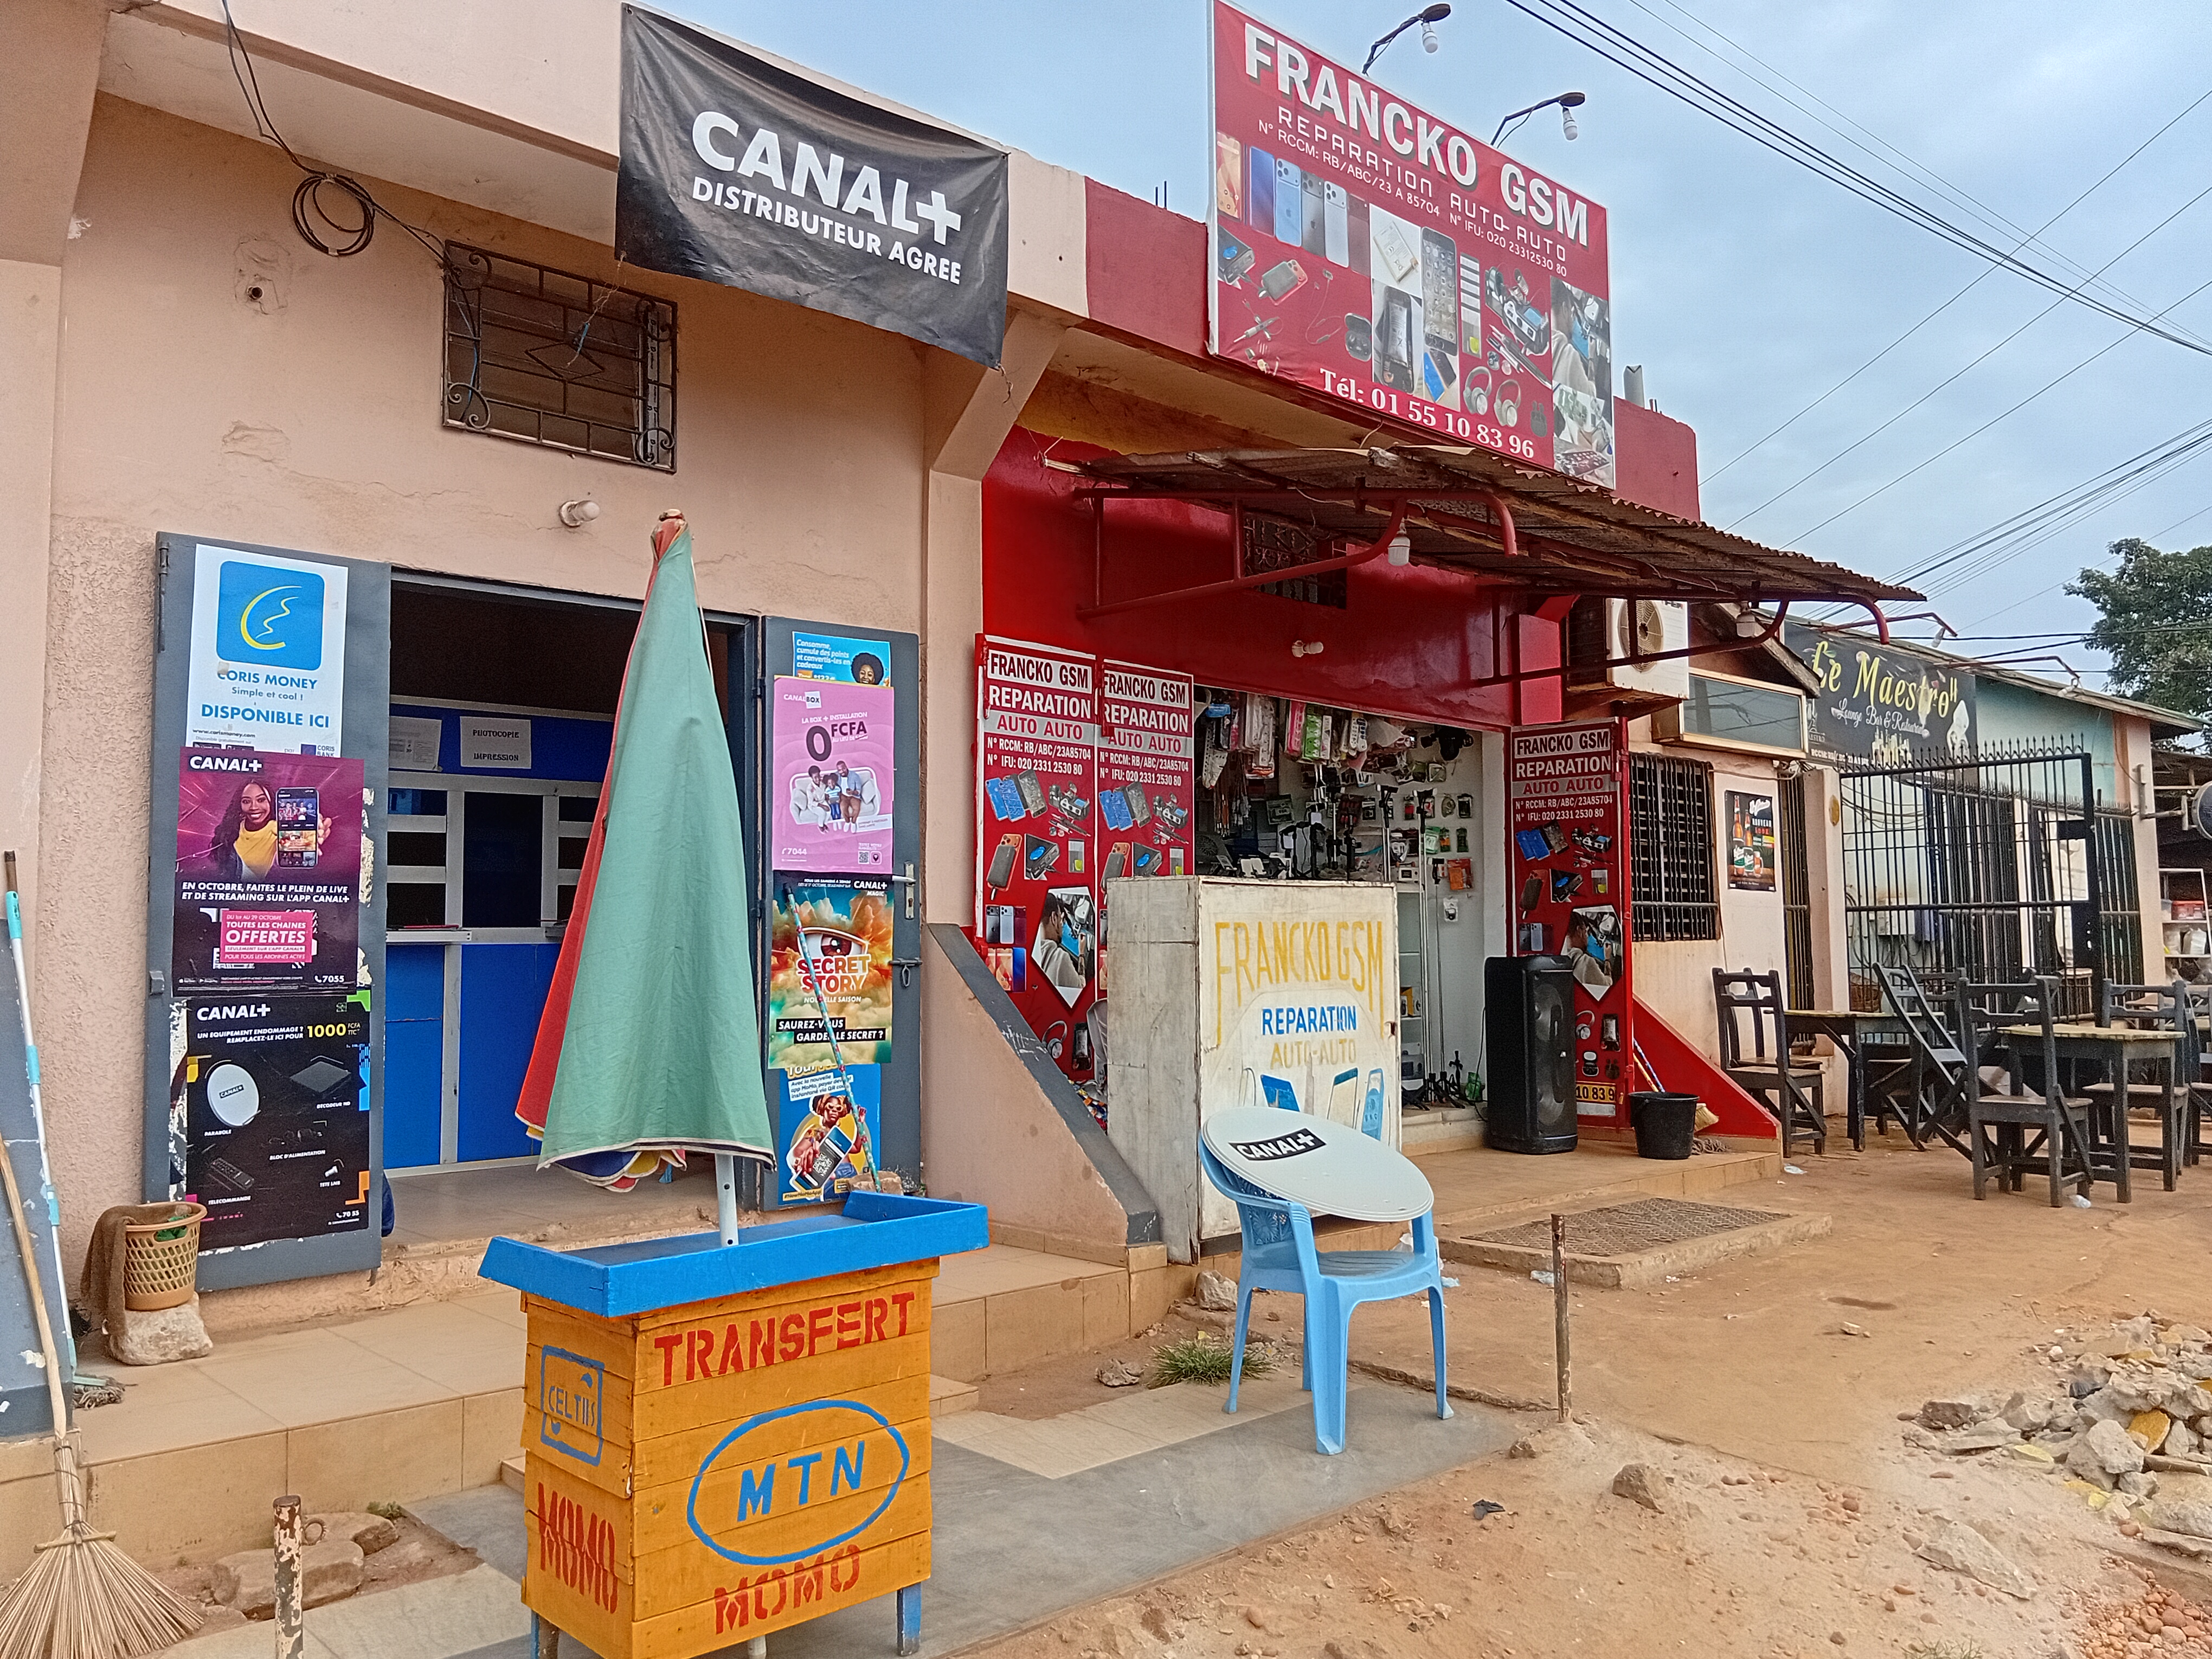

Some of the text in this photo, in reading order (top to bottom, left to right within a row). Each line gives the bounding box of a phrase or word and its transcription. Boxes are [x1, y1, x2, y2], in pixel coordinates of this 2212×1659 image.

[1245, 23, 1587, 247] FRANCKO GSM
[1278, 106, 1432, 197] REPARATION
[692, 111, 961, 245] CANAL+
[1259, 119, 1439, 217] N° RCCM: RB/ABC/23 A 85704
[692, 177, 961, 284] DISTRIBUTEUR AGREE
[1450, 213, 1567, 277] N° IFU: 020 23312530 80
[1320, 369, 1534, 459] Tél: 01 55 10 83 96
[796, 639, 831, 650] Consomme,
[217, 670, 318, 690] CORIS MONEY
[991, 653, 1088, 689] FRANCKO GSM
[232, 686, 263, 698] Simple
[278, 691, 297, 701] cool
[989, 685, 1091, 719] REPARATION
[1161, 682, 1185, 704] GSM
[201, 704, 329, 728] DISPONIBLE ICI
[830, 712, 867, 721] INSTALLATION
[1104, 703, 1188, 733] REPARATION
[473, 729, 519, 738] PHOTOCOPIE
[831, 721, 867, 737] FCFA
[997, 715, 1083, 740] AUTO AUTO
[806, 725, 832, 762] 0
[987, 737, 1091, 760] N° RCCM: RB/ABC/23A85704
[1108, 731, 1181, 753] AUTO AUTO
[1517, 731, 1609, 755] FRANCKO GSM
[189, 756, 262, 772] CANAL+
[473, 753, 519, 761] IMPRESSION
[987, 754, 1082, 775] N° IFU: 020 2331 2530 80
[1516, 756, 1611, 777] REPARATION
[1100, 768, 1109, 778] N°
[1112, 769, 1124, 780] IFU:
[1126, 770, 1138, 782] 020
[1140, 772, 1155, 784] 2331
[1156, 774, 1172, 785] 2530
[1523, 777, 1604, 795] AUTO AUTO
[198, 883, 244, 892] OCTOBRE,
[854, 881, 887, 889] CANAL+
[208, 892, 264, 901] STREAMING
[798, 956, 870, 974] SECRET
[802, 975, 866, 993] STORY
[1216, 921, 1384, 1046] FRANCKO GSM
[197, 1004, 271, 1021] CANAL+
[1262, 1006, 1356, 1035] REPARATION
[227, 1035, 274, 1044] REMPLACEZ-LE
[307, 1024, 346, 1038] 1000
[796, 1033, 833, 1041] GARDE
[847, 1031, 877, 1039] SECRET
[1270, 1038, 1355, 1069] AUTO-AUTO
[220, 1085, 243, 1097] CANAL+
[791, 1078, 804, 1086] Avec
[1576, 1086, 1589, 1098] 10
[1592, 1087, 1605, 1100] 83
[1237, 1132, 1315, 1159] CANAL+
[654, 1291, 915, 1386] TRANSFERT
[737, 1439, 865, 1522] MTN
[538, 1481, 619, 1615] MOMO
[713, 1544, 861, 1635] MOMO
